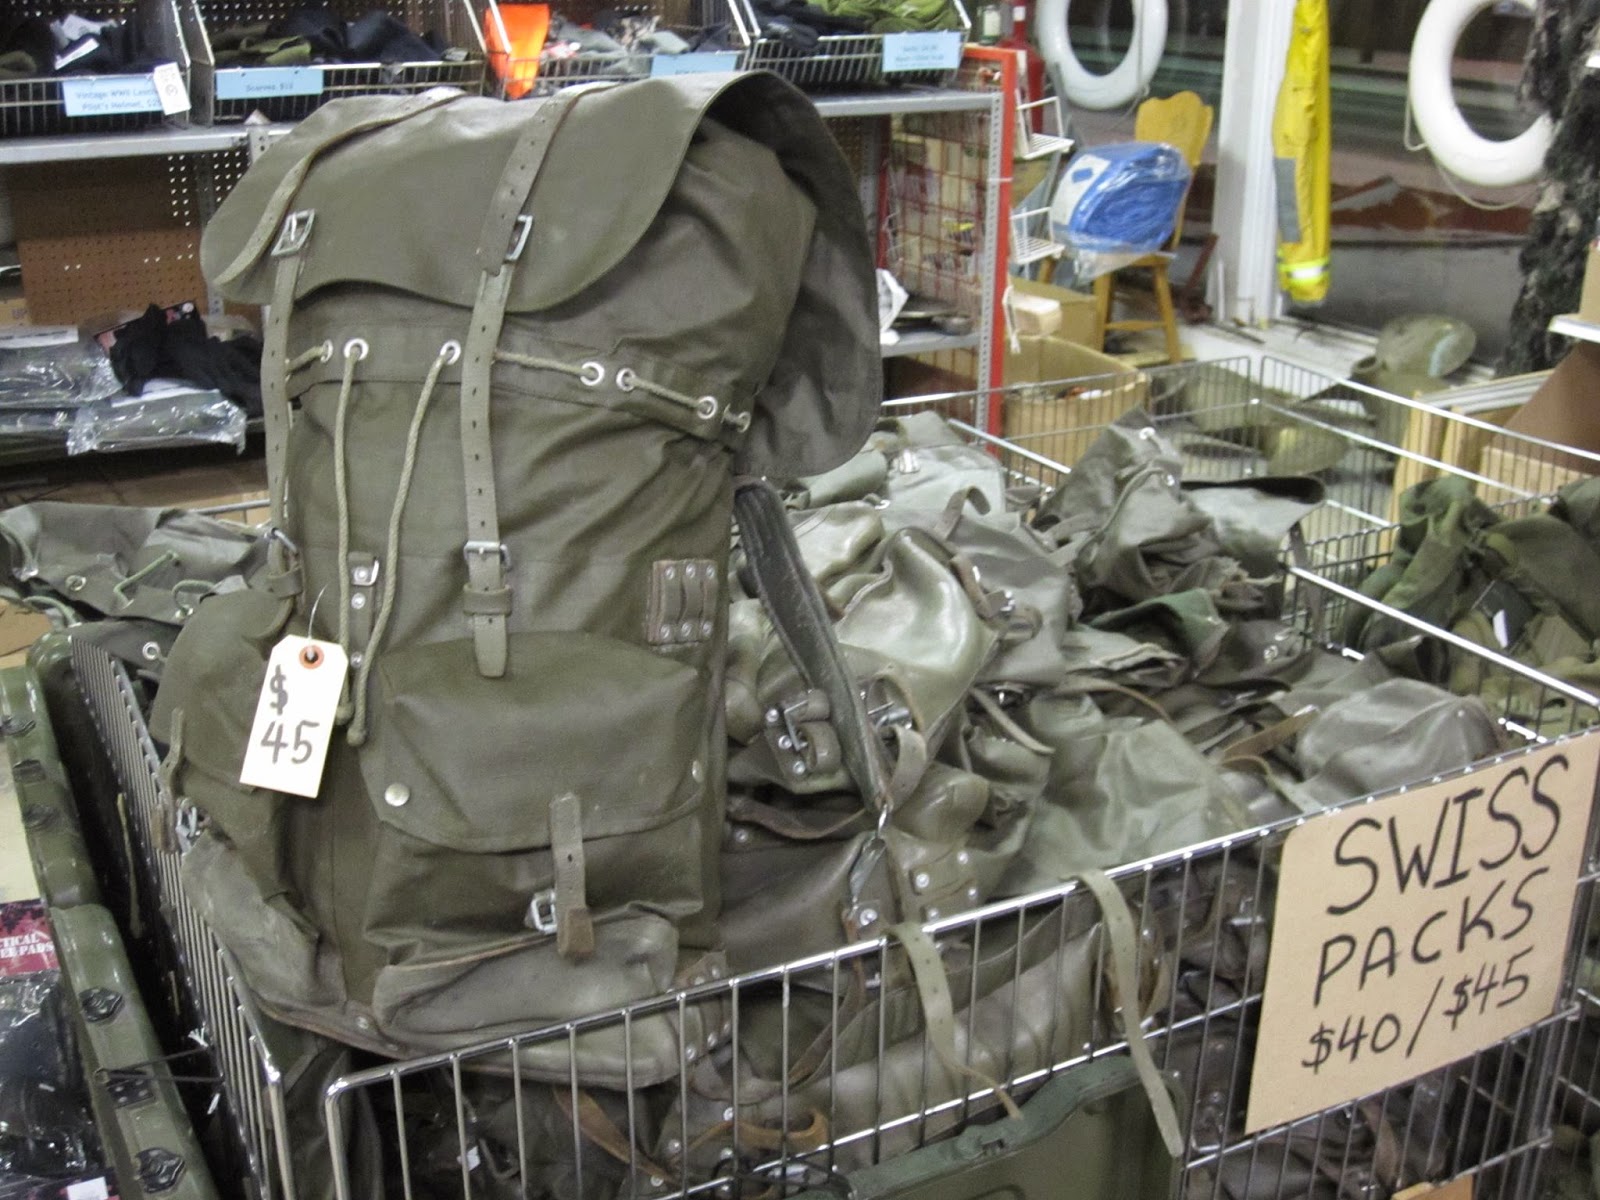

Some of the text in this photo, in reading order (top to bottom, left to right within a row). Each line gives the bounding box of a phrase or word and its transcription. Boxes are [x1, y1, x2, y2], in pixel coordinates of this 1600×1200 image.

[269, 664, 289, 716] $
[260, 719, 320, 765] 45
[1326, 754, 1570, 916] SWISS
[0, 930, 41, 948] TICAL
[19, 942, 55, 956] PADS
[1313, 866, 1551, 1009] PACKS
